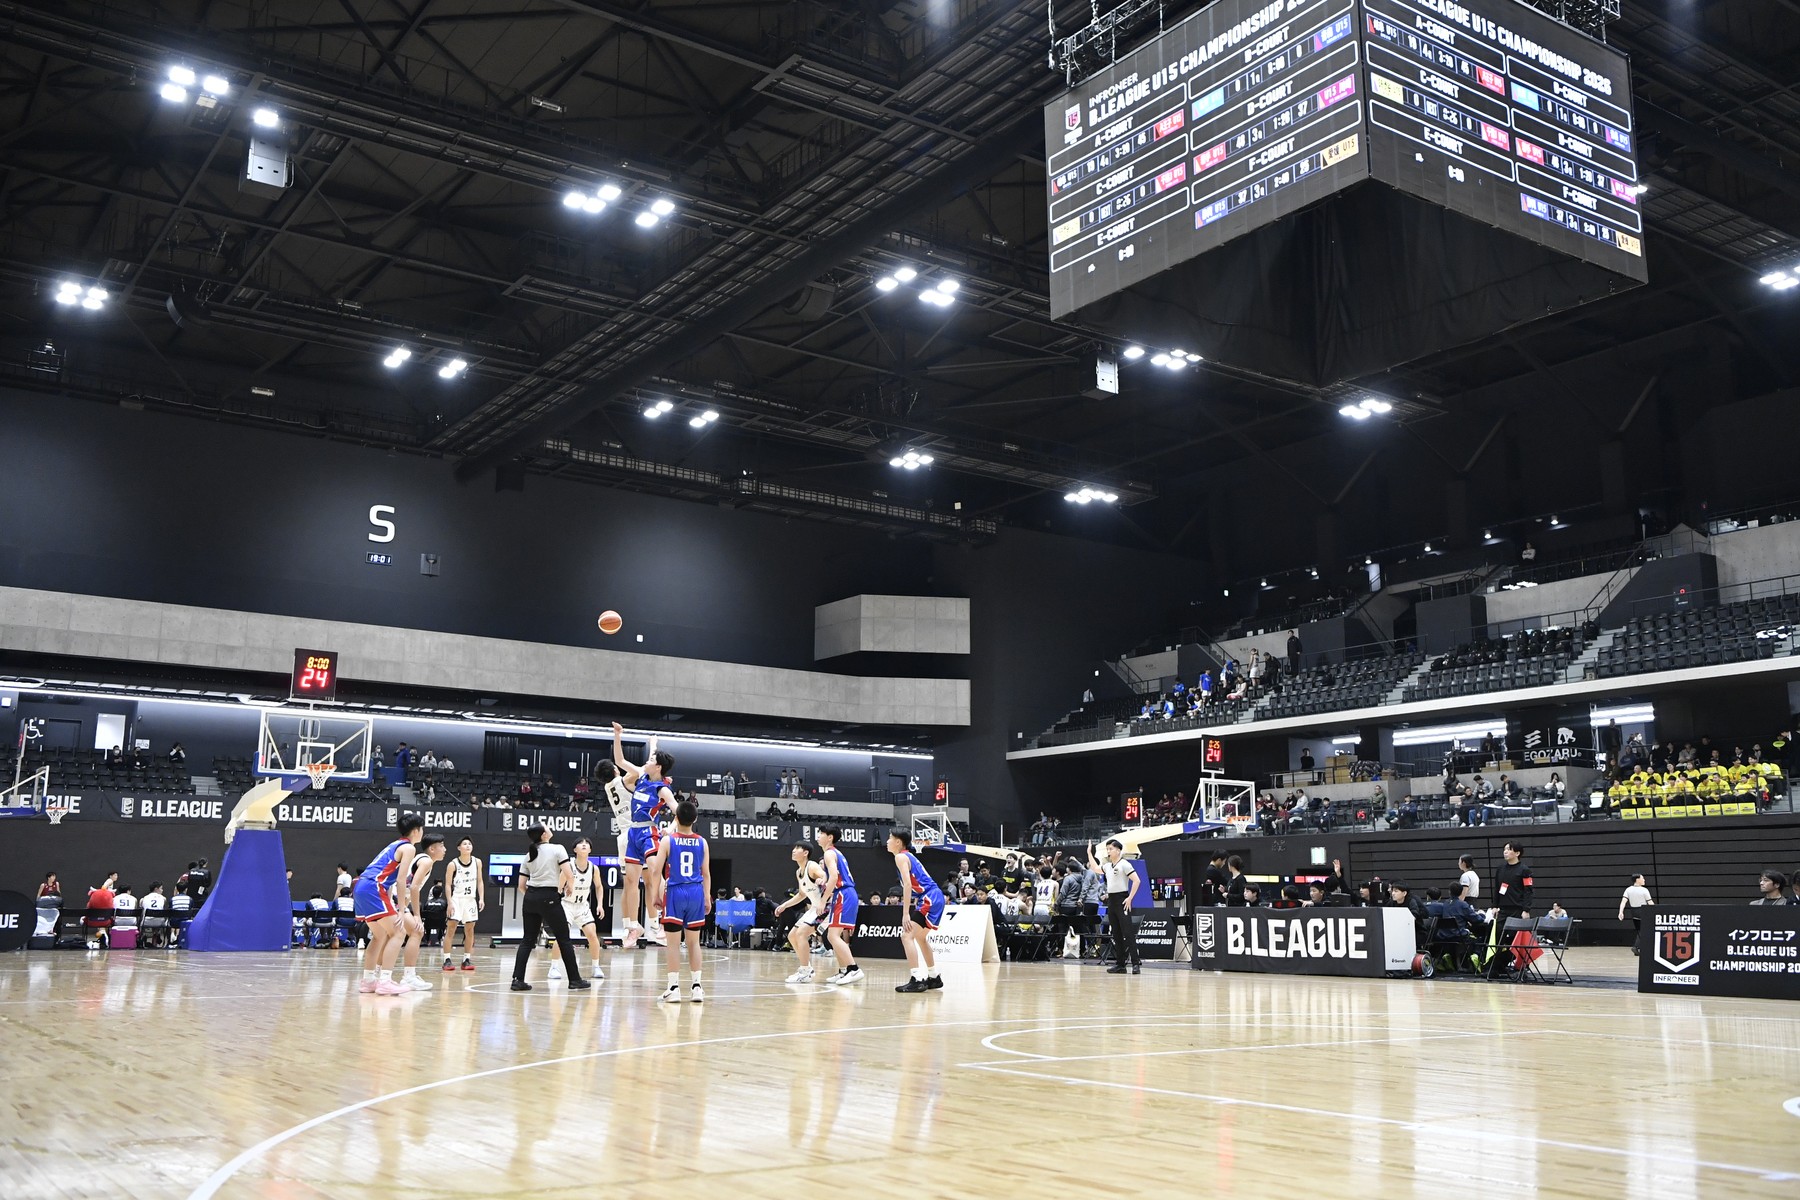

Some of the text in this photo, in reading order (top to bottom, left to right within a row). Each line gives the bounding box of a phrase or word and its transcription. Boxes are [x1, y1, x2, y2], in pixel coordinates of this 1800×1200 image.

[1472, 13, 1497, 40] U15
[1497, 25, 1582, 80] CHAMPIONSHIP
[1089, 78, 1151, 127] B.LEAGUE
[1152, 62, 1179, 91] U15
[1180, 0, 1284, 75] CHAMPIONSHIP
[1089, 72, 1138, 108] INFRONEER
[368, 504, 396, 543] S
[307, 656, 330, 670] 8:00
[300, 668, 328, 688] 24
[1206, 748, 1221, 762] 24
[610, 787, 620, 806] 5
[141, 800, 223, 819] B.LEAGUE
[278, 804, 354, 823] B.LEAGUE
[404, 809, 472, 828] EAGUE
[1125, 805, 1138, 819] 24
[723, 823, 778, 840] B.LEAGUE
[674, 837, 700, 846] YAKETA
[680, 851, 694, 877] 8
[607, 867, 617, 887] 0
[1038, 885, 1050, 897] 44
[119, 899, 130, 907] 51
[151, 899, 158, 908] 2
[1655, 914, 1701, 926] B.LEAGUE
[868, 925, 904, 938] EGOZAR
[1226, 916, 1368, 959] B.LEAGUE
[1728, 929, 1796, 941] インフロニア
[1663, 931, 1692, 960] 15
[1727, 945, 1797, 957] B.LEAGUE U15
[1709, 960, 1786, 973] CHAMPIONSHIP
